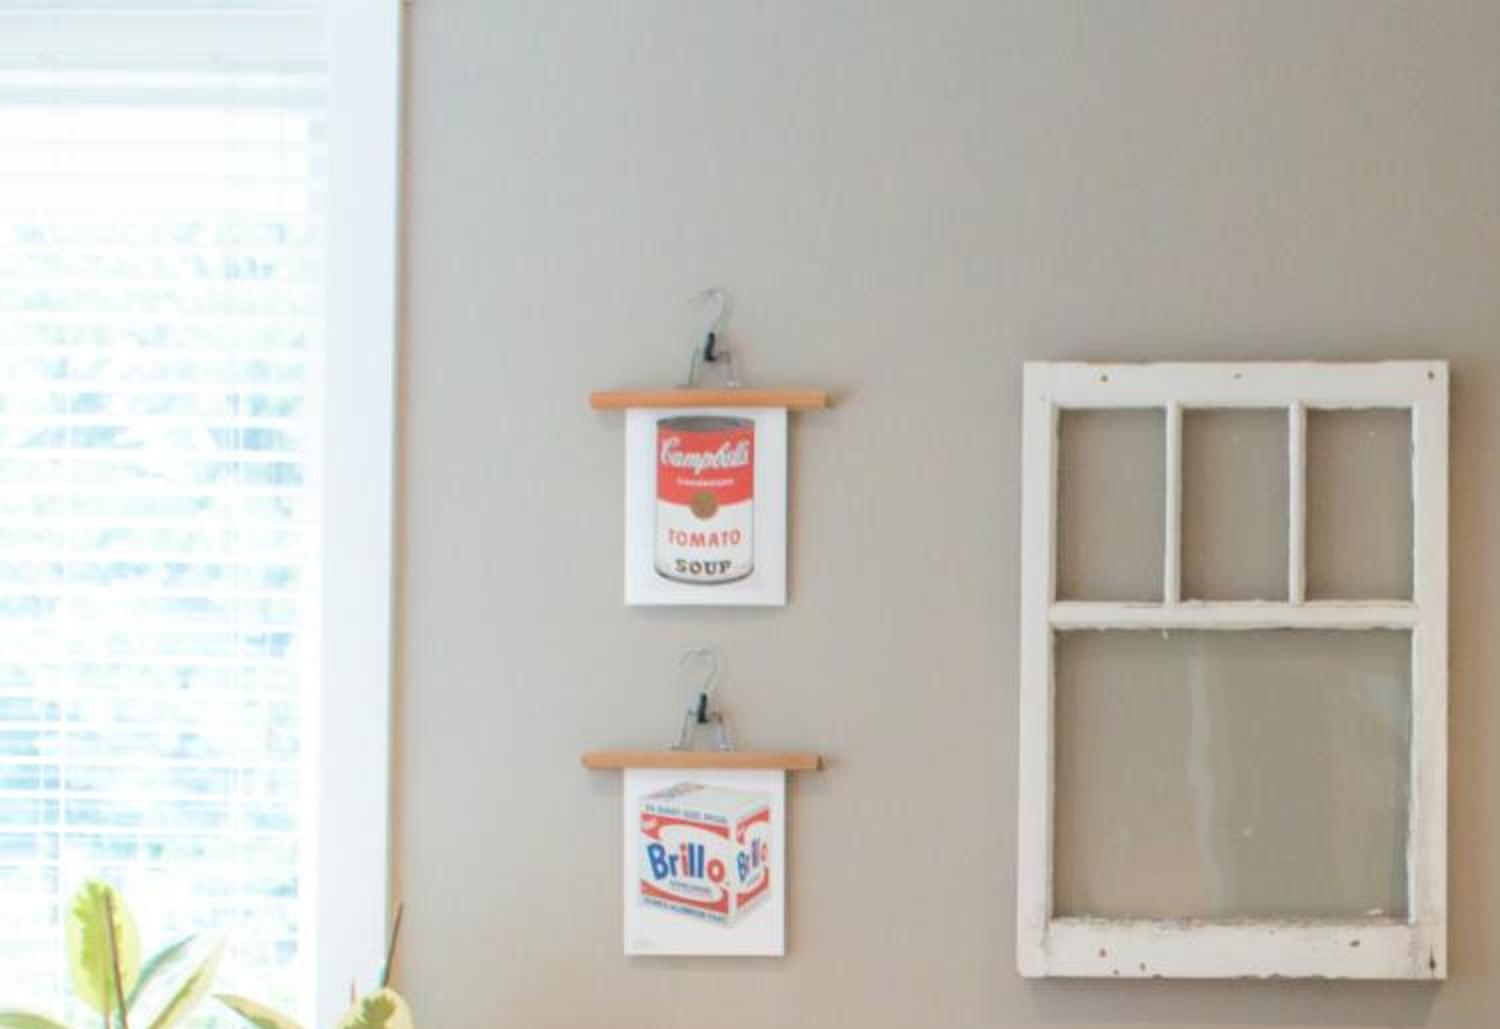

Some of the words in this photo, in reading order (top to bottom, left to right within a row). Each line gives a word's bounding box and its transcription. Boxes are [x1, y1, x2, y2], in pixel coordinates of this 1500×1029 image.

[668, 527, 742, 548] TOMATO
[675, 558, 732, 575] SOUP
[646, 842, 725, 883] Brillo
